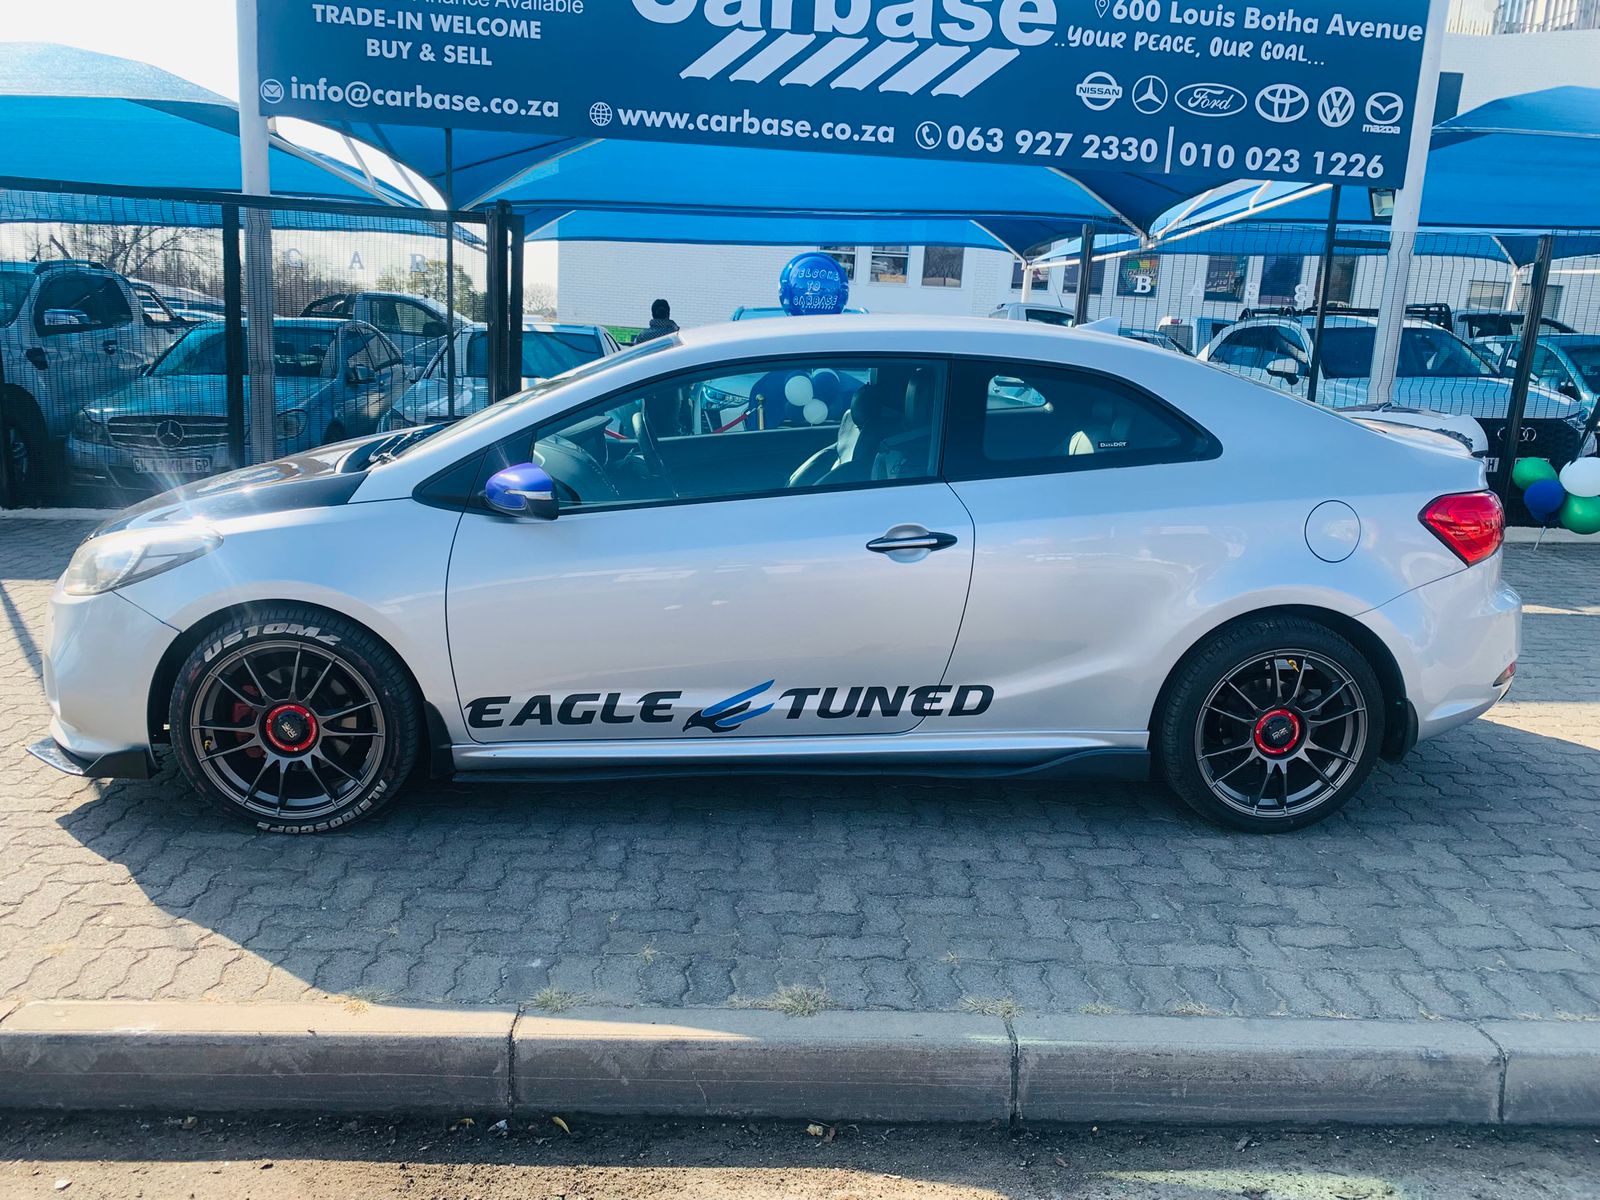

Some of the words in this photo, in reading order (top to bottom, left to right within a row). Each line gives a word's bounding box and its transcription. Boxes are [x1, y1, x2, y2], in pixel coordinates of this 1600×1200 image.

[312, 4, 423, 32] TRADE-IN
[430, 13, 542, 40] WELCOME
[1111, 0, 1161, 22] 600
[1169, 1, 1235, 28] Louis
[1243, 6, 1319, 34] Botha
[1326, 13, 1423, 42] Avenue
[366, 38, 413, 60] BUY
[418, 44, 436, 62] &
[443, 44, 493, 66] SELL
[1210, 36, 1252, 59] OUR
[290, 75, 559, 118] info@carbase.co.za
[1078, 86, 1121, 97] NISSAN
[1188, 88, 1235, 110] Ford
[617, 107, 895, 143] www.carbase.co.za
[1362, 124, 1401, 134] mazda
[946, 125, 1003, 152] 063
[1014, 129, 1073, 157] 927
[1082, 134, 1159, 163] 2330
[1179, 143, 1235, 169] 010
[1244, 146, 1300, 173] 023
[1313, 150, 1384, 179] 1226
[464, 690, 682, 729] EAGLE
[778, 684, 995, 719] TUNED
